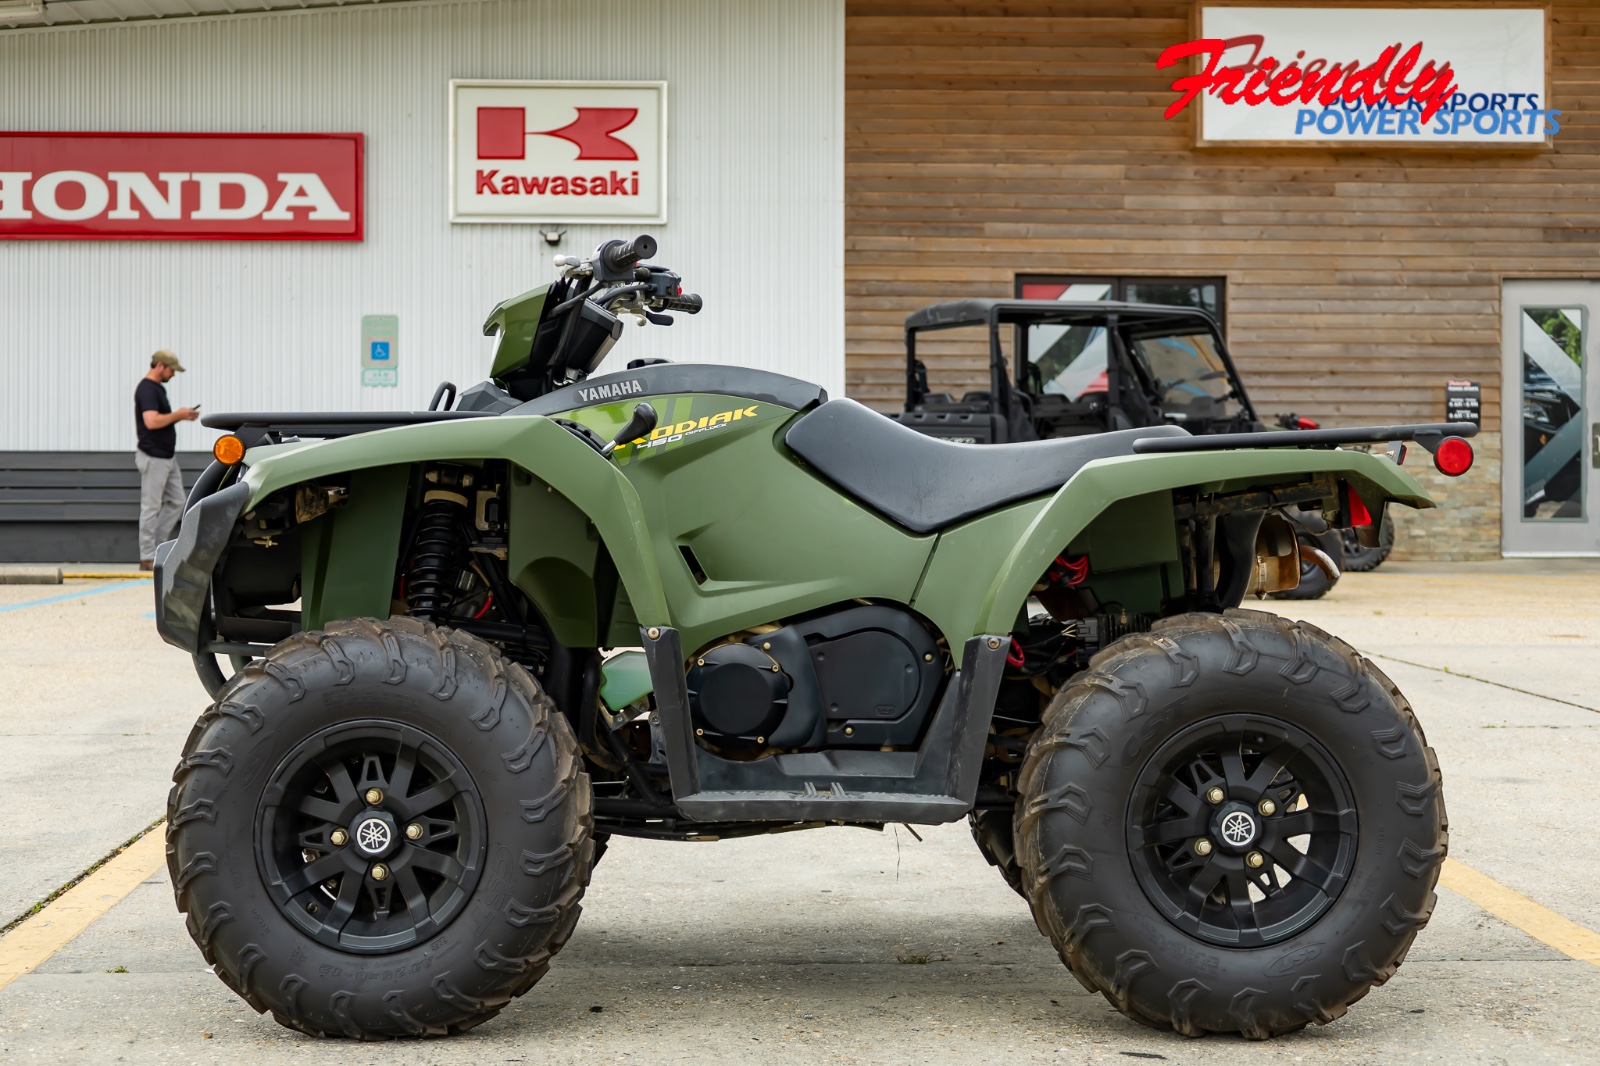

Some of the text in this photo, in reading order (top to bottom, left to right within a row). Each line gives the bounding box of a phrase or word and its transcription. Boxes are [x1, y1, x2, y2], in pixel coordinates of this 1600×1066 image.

[475, 169, 639, 196] Kawasaki
[578, 379, 643, 402] YAMAHA
[636, 433, 683, 449] 450
